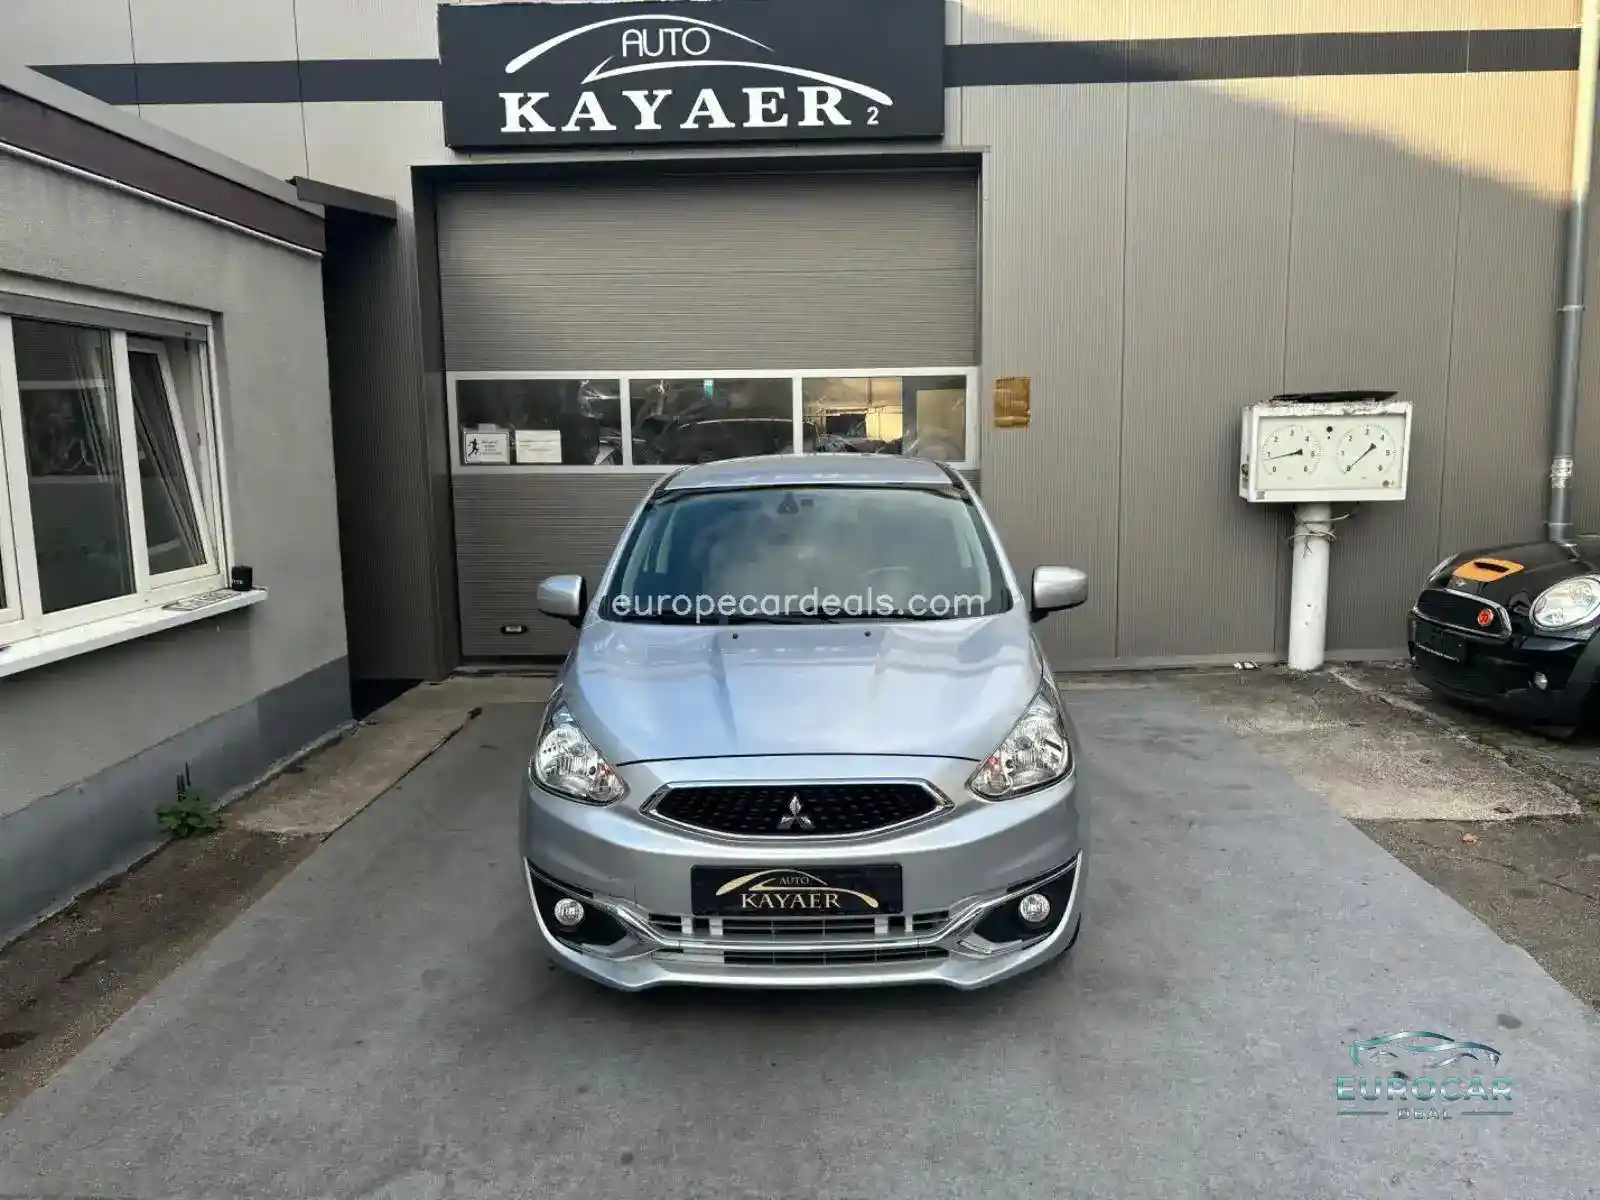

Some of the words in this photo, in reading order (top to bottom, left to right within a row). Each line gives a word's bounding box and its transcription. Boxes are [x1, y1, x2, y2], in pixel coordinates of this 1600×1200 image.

[621, 27, 711, 58] AUTO
[498, 85, 851, 133] KAYAER
[866, 106, 879, 126] 2
[779, 876, 811, 885] AUTO
[740, 893, 841, 909] KAYAER
